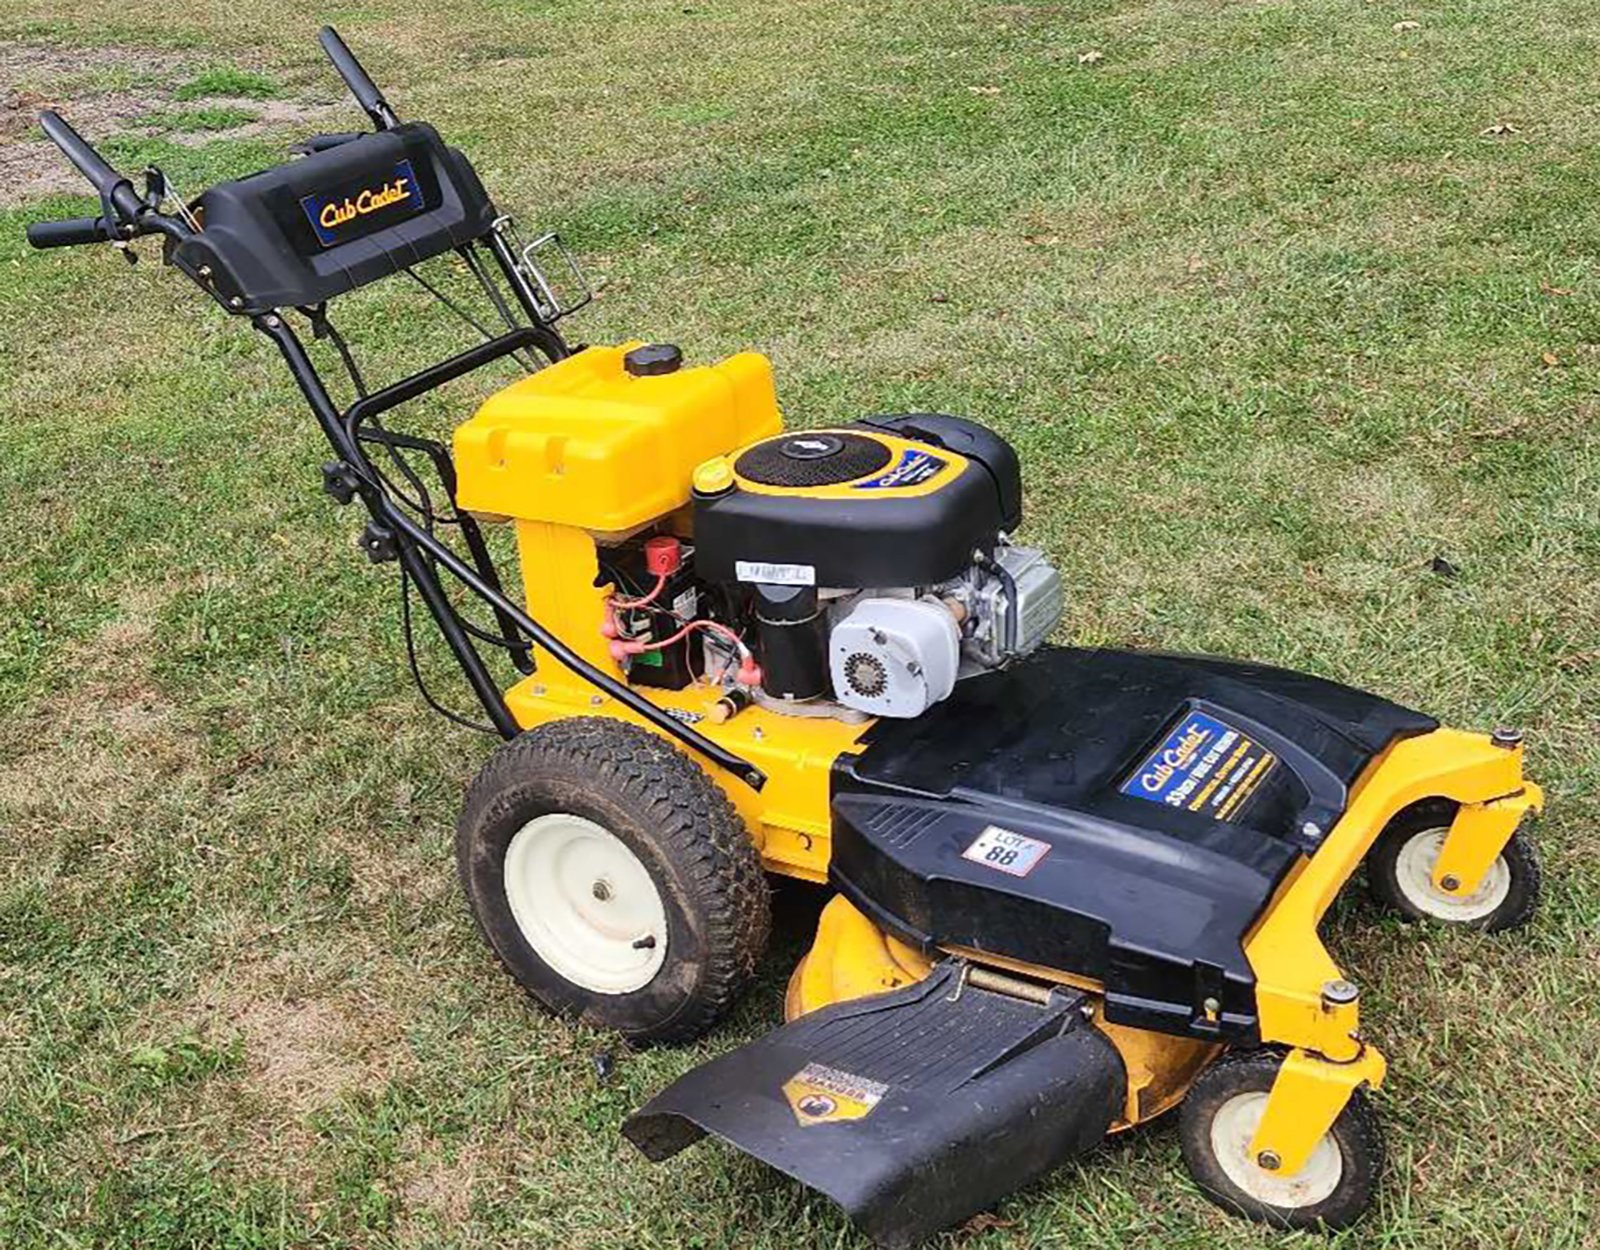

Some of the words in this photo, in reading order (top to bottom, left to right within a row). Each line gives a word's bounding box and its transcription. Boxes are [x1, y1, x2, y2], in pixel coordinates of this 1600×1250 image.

[320, 196, 357, 228] Cub
[356, 178, 411, 214] Cadet
[1141, 763, 1173, 792] Cub
[1163, 723, 1210, 768] Cadet
[985, 846, 1018, 866] 88
[994, 832, 1026, 847] LOT
